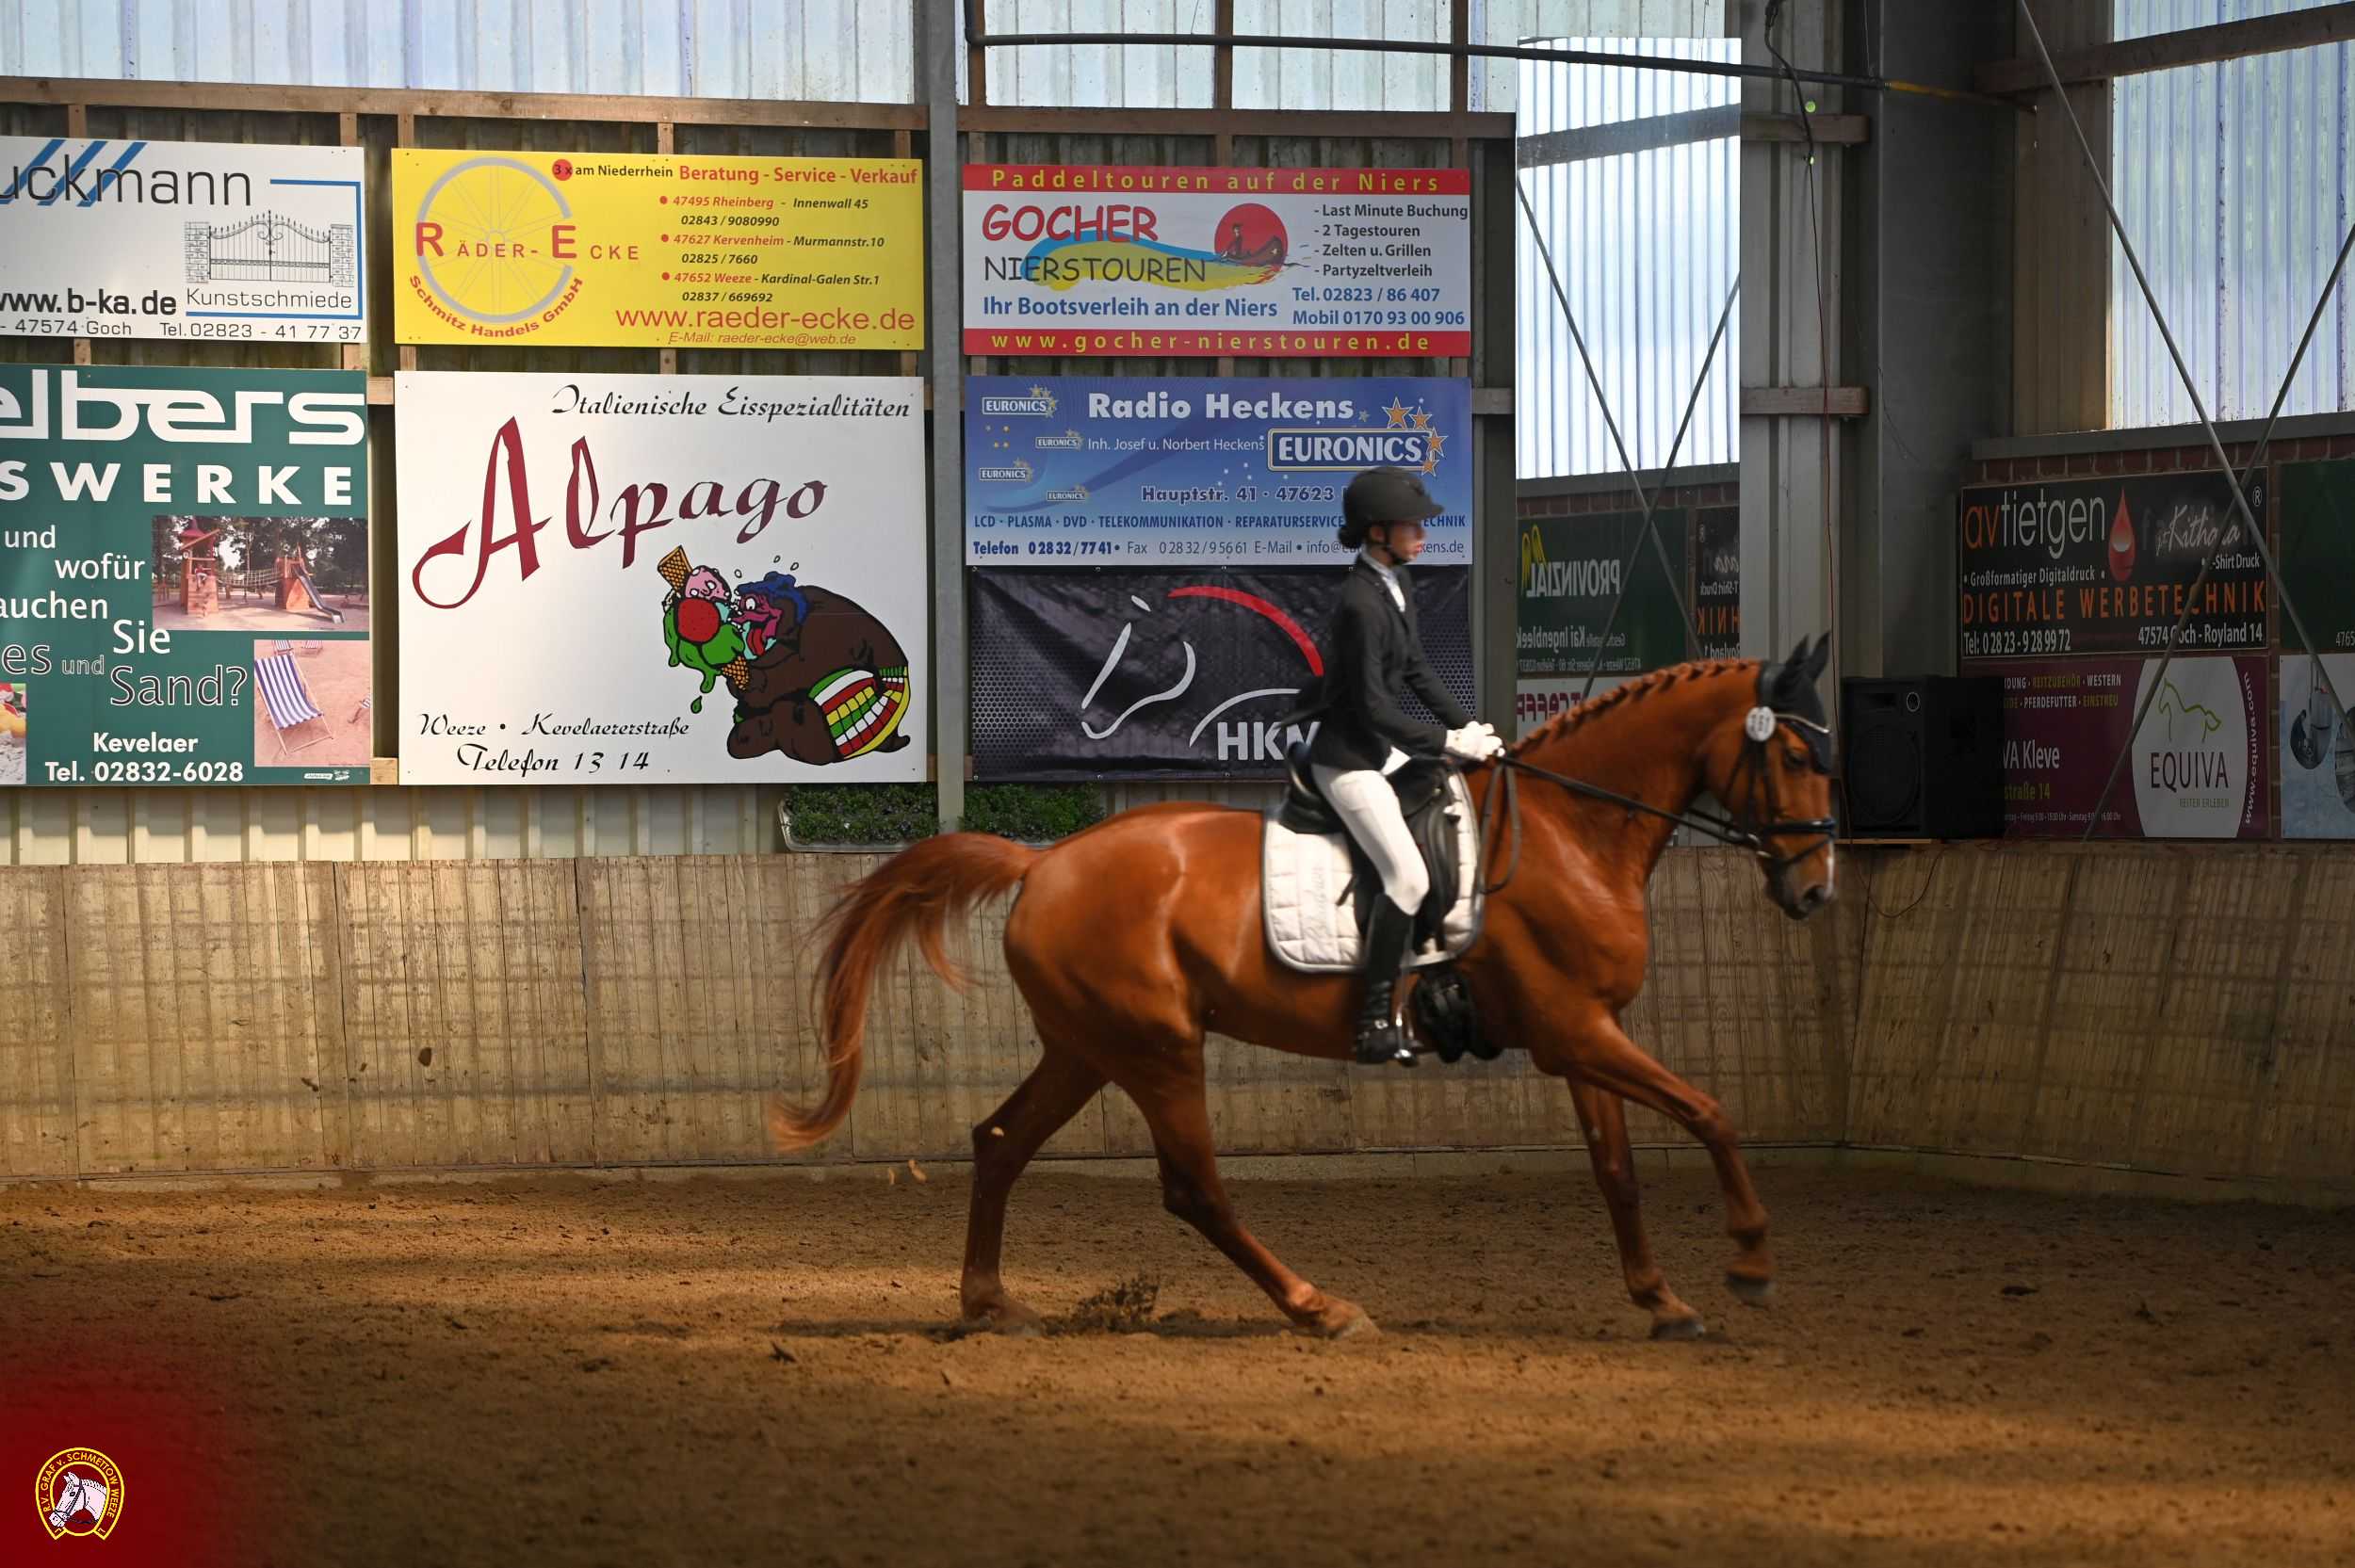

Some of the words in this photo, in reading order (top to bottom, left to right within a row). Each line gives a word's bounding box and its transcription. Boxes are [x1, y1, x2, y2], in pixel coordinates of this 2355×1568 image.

[598, 165, 673, 177] Niederrhein
[680, 166, 758, 185] Beratung
[774, 168, 836, 183] Service
[851, 169, 918, 184] Verkauf
[993, 170, 1209, 189] Paddeltouren
[1228, 172, 1274, 190] auf
[1293, 173, 1340, 190] der
[1359, 173, 1437, 191] Niers
[674, 196, 709, 206] 47495
[712, 196, 773, 210] Rheinberg
[793, 199, 852, 208] Innenwall
[854, 200, 869, 209] 45
[1324, 204, 1351, 217] Last
[1355, 204, 1403, 217] Minute
[1407, 204, 1468, 219] Buchung
[681, 216, 718, 225] 02843
[728, 217, 779, 226] 9080990
[982, 203, 1159, 243] GOCHER
[1323, 224, 1330, 235] 2
[1334, 224, 1420, 239] Tagestouren
[674, 234, 710, 244] 47627
[710, 234, 784, 245] Kervenheim
[1323, 244, 1366, 256] Zelten
[1371, 248, 1382, 256] u.
[1386, 244, 1431, 256] Grillen
[682, 253, 718, 264] 02825
[729, 254, 757, 264] 7660
[984, 255, 1206, 283] NIERSTOUREN
[674, 272, 711, 283] 47652
[715, 273, 752, 283] Weeze
[761, 274, 850, 284] Kardinal-Galen
[1324, 264, 1432, 279] Partyzeltverleih
[187, 288, 351, 308] Kunstschmiede
[682, 292, 720, 301] 02837
[729, 293, 772, 301] 669692
[1292, 286, 1320, 300] Tel.
[1324, 288, 1372, 301] 02823
[1388, 288, 1406, 301] 86
[1410, 288, 1439, 301] 407
[410, 275, 466, 331] Schmitz
[470, 322, 540, 338] Handels
[543, 277, 584, 323] GmbH
[984, 296, 1013, 315] Ihr
[1018, 297, 1148, 315] Bootsverleih
[1155, 303, 1179, 315] an
[1186, 298, 1220, 315] der
[1226, 299, 1277, 316] Niers
[615, 306, 916, 331] www.raeder-ecke.de
[1293, 310, 1339, 324] Mobil
[1343, 311, 1383, 324] 0170
[1388, 311, 1406, 324] 93
[1411, 312, 1430, 324] 00
[1435, 312, 1464, 324] 906
[15, 318, 78, 334] 47574
[86, 320, 132, 335] Goch
[275, 325, 295, 338] 41
[308, 326, 330, 338] 77
[339, 327, 361, 339] 37
[669, 331, 713, 345] E-Mail:
[717, 332, 856, 346] raeder-ecke@web.de
[992, 332, 1430, 353] www.gocher-nierstouren.de
[552, 384, 707, 417] Italienische
[718, 386, 911, 424] Eisspezialitäten
[985, 400, 1048, 412] EURONICS
[1089, 392, 1191, 418] Radio
[1206, 393, 1353, 418] Heckens
[1038, 438, 1078, 447] EURONICS
[1089, 438, 1110, 449] Inh.
[1114, 438, 1145, 450] Josef
[1149, 441, 1159, 450] u.
[1163, 438, 1210, 450] Norbert
[1213, 440, 1265, 451] Heckens
[1279, 436, 1421, 461] EURONICS
[982, 470, 1025, 478] EURONICS
[1141, 485, 1228, 506] Hauptstr.
[1236, 486, 1258, 501] 41
[1275, 485, 1334, 502] 47623
[412, 415, 829, 609] Alpago
[975, 515, 995, 527] LCD
[1008, 516, 1051, 527] PLASMA
[1064, 516, 1086, 527] DVD
[1098, 516, 1223, 527] TELEKOMMUNIKATION
[1235, 516, 1344, 527] REPARATURSERVICE
[1965, 489, 2105, 559] avtietgen
[2168, 505, 2241, 553] Kithaa
[6, 525, 56, 548] und
[973, 541, 1018, 554] Telefon
[1128, 542, 1146, 554] Fax
[1255, 541, 1291, 553] E-Mail
[55, 553, 145, 579] wofür
[2209, 553, 2233, 571] -Shirt
[2236, 551, 2260, 569] Druck
[1971, 568, 2037, 588] Großformatiger
[2039, 565, 2095, 587] Digitaldruck
[1964, 589, 2065, 623] DIGITALE
[2080, 582, 2267, 618] WERBETEHNIK
[113, 620, 171, 654] Sie
[2138, 625, 2168, 645] 47574
[2204, 622, 2246, 647] Royland
[2250, 622, 2262, 642] 14
[61, 655, 105, 675] und
[110, 664, 248, 706] Sand?
[2087, 673, 2121, 687] WESTERN
[2023, 695, 2076, 709] PFERDEFUTTER
[420, 713, 486, 736] Weeze
[521, 713, 690, 738] Kevelaererstraße
[94, 732, 198, 752] Kevelaer
[2244, 671, 2259, 824] www.equiva.com
[457, 743, 560, 778] Telefon
[574, 752, 605, 774] 13
[619, 752, 649, 770] 14
[2022, 739, 2060, 769] Kleve
[45, 761, 85, 782] Tel.
[95, 762, 243, 782] 02832-6028
[2151, 752, 2229, 792] EQUIVA
